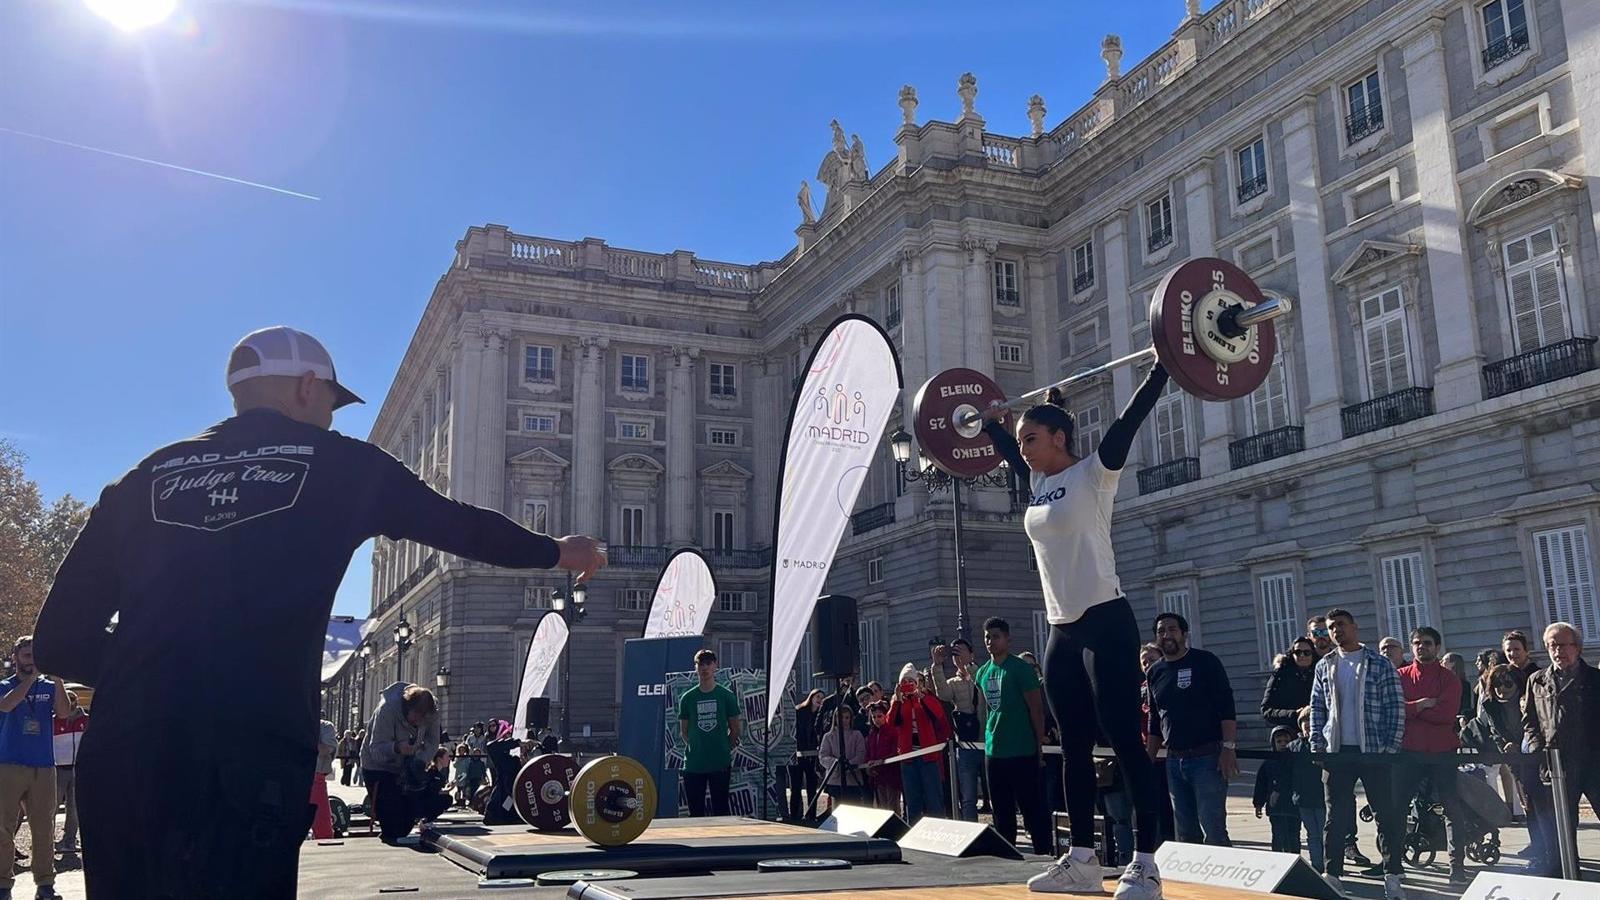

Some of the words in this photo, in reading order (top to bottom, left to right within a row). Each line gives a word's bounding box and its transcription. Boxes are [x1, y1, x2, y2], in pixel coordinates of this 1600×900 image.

[1181, 290, 1196, 355] ELEIKO
[1207, 330, 1237, 353] ELEIKO
[940, 383, 983, 398] ELEIKO
[929, 417, 947, 430] 25
[808, 425, 870, 444] MADRID
[152, 453, 220, 473] HEAD
[224, 445, 315, 460] JUDGE
[952, 444, 995, 460] ELEIKO
[160, 469, 236, 500] Judge
[241, 464, 296, 484] Crew
[793, 560, 827, 570] MADRID
[543, 763, 553, 775] 25
[525, 781, 540, 817] ELEIKO
[587, 781, 596, 825] ELEIKO
[553, 809, 563, 822] 25
[1160, 850, 1266, 887] foodspring
